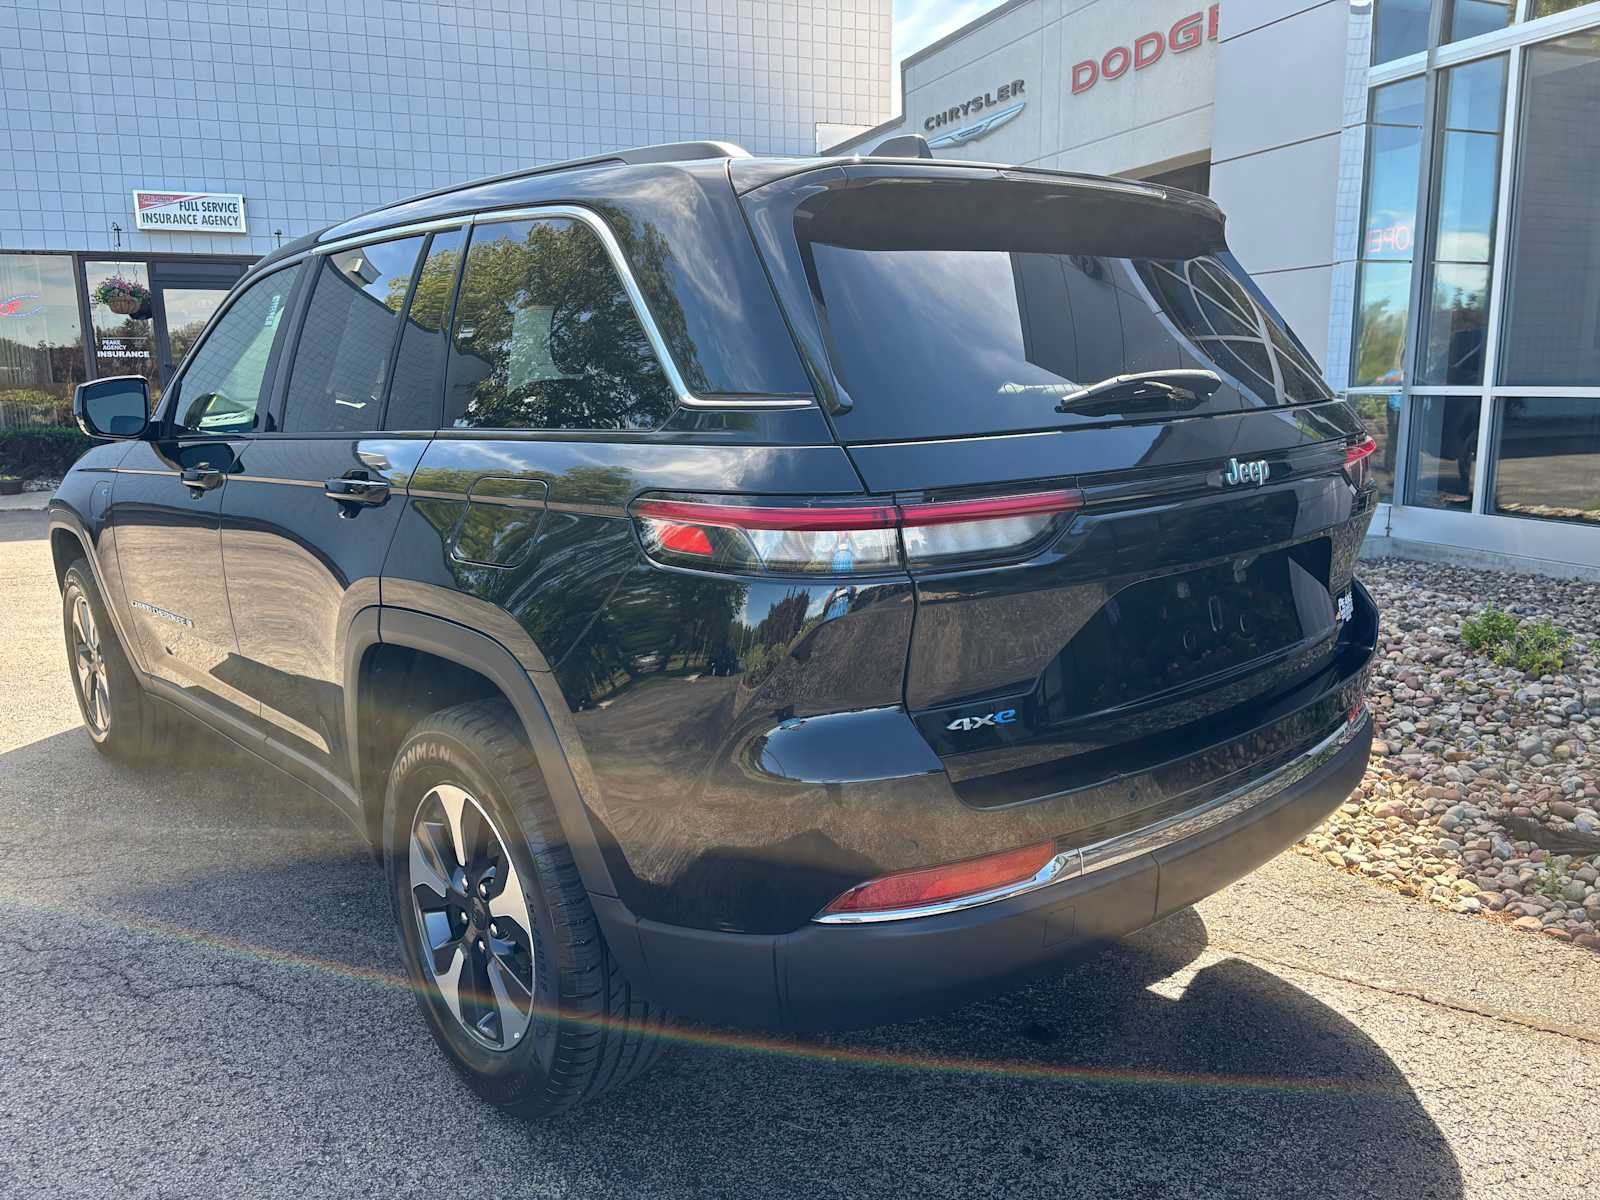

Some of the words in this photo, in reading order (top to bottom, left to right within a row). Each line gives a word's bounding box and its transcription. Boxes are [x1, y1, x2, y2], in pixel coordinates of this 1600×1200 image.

[924, 79, 1025, 131] CHRYSLER
[180, 201, 199, 212] FULL
[202, 202, 238, 213] SERVICE
[142, 213, 198, 225] INSURANCE
[201, 215, 239, 226] AGENCY
[1225, 458, 1270, 486] Jeep
